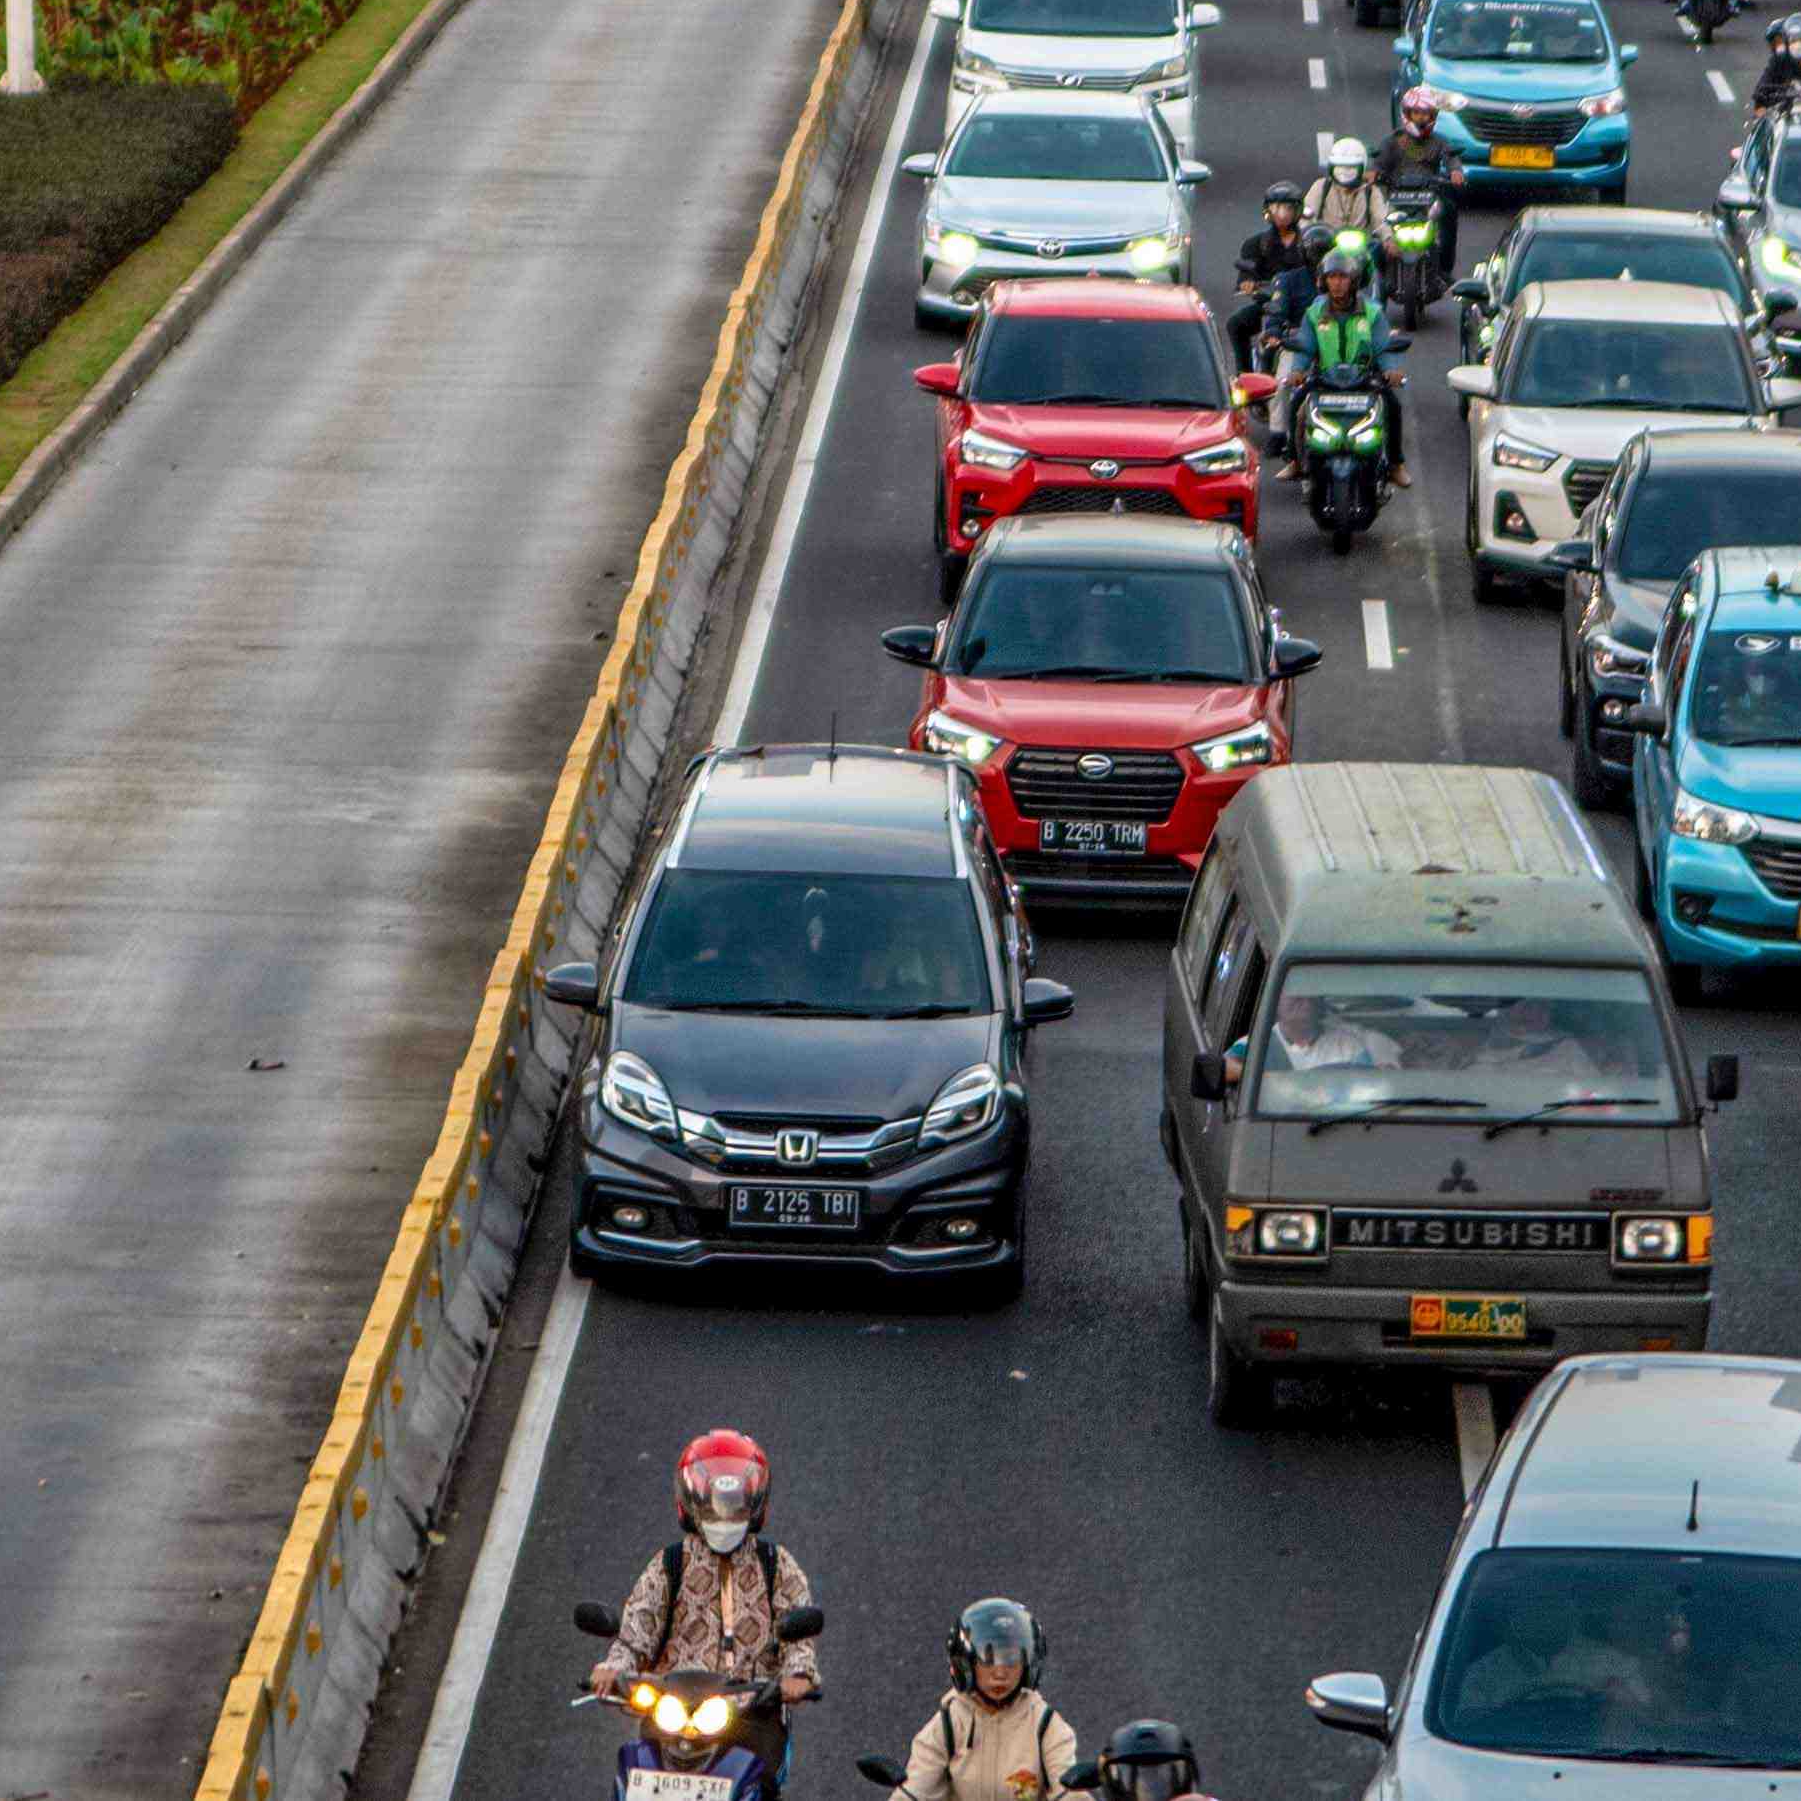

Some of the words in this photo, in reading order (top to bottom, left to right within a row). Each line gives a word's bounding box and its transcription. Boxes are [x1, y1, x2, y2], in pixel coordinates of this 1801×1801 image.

[1044, 821, 1055, 841] B
[1065, 821, 1104, 842] 2250
[1112, 823, 1146, 844] TRM
[737, 1189, 749, 1212] B
[822, 1192, 856, 1215] TBT
[1349, 1218, 1597, 1246] MITSUBISHI
